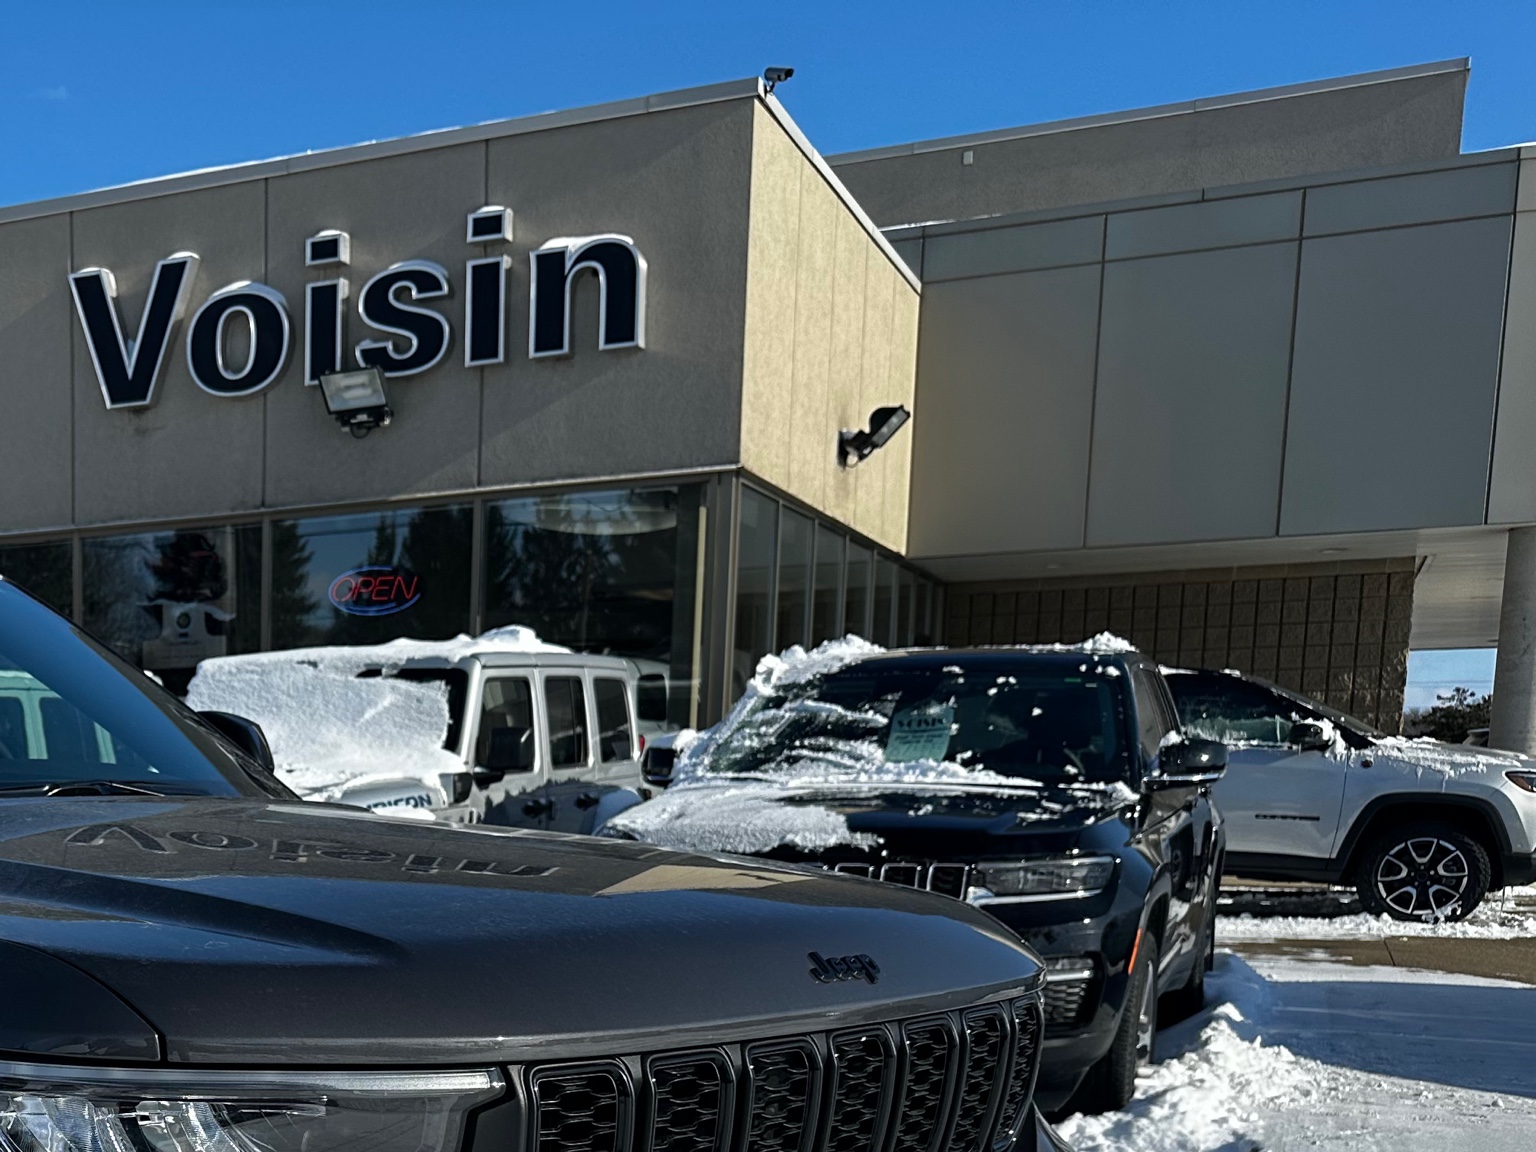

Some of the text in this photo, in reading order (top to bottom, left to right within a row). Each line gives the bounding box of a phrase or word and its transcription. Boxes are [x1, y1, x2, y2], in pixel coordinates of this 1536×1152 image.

[68, 205, 647, 410] Voisin
[332, 575, 419, 602] OPEN
[807, 951, 881, 985] Jeep
